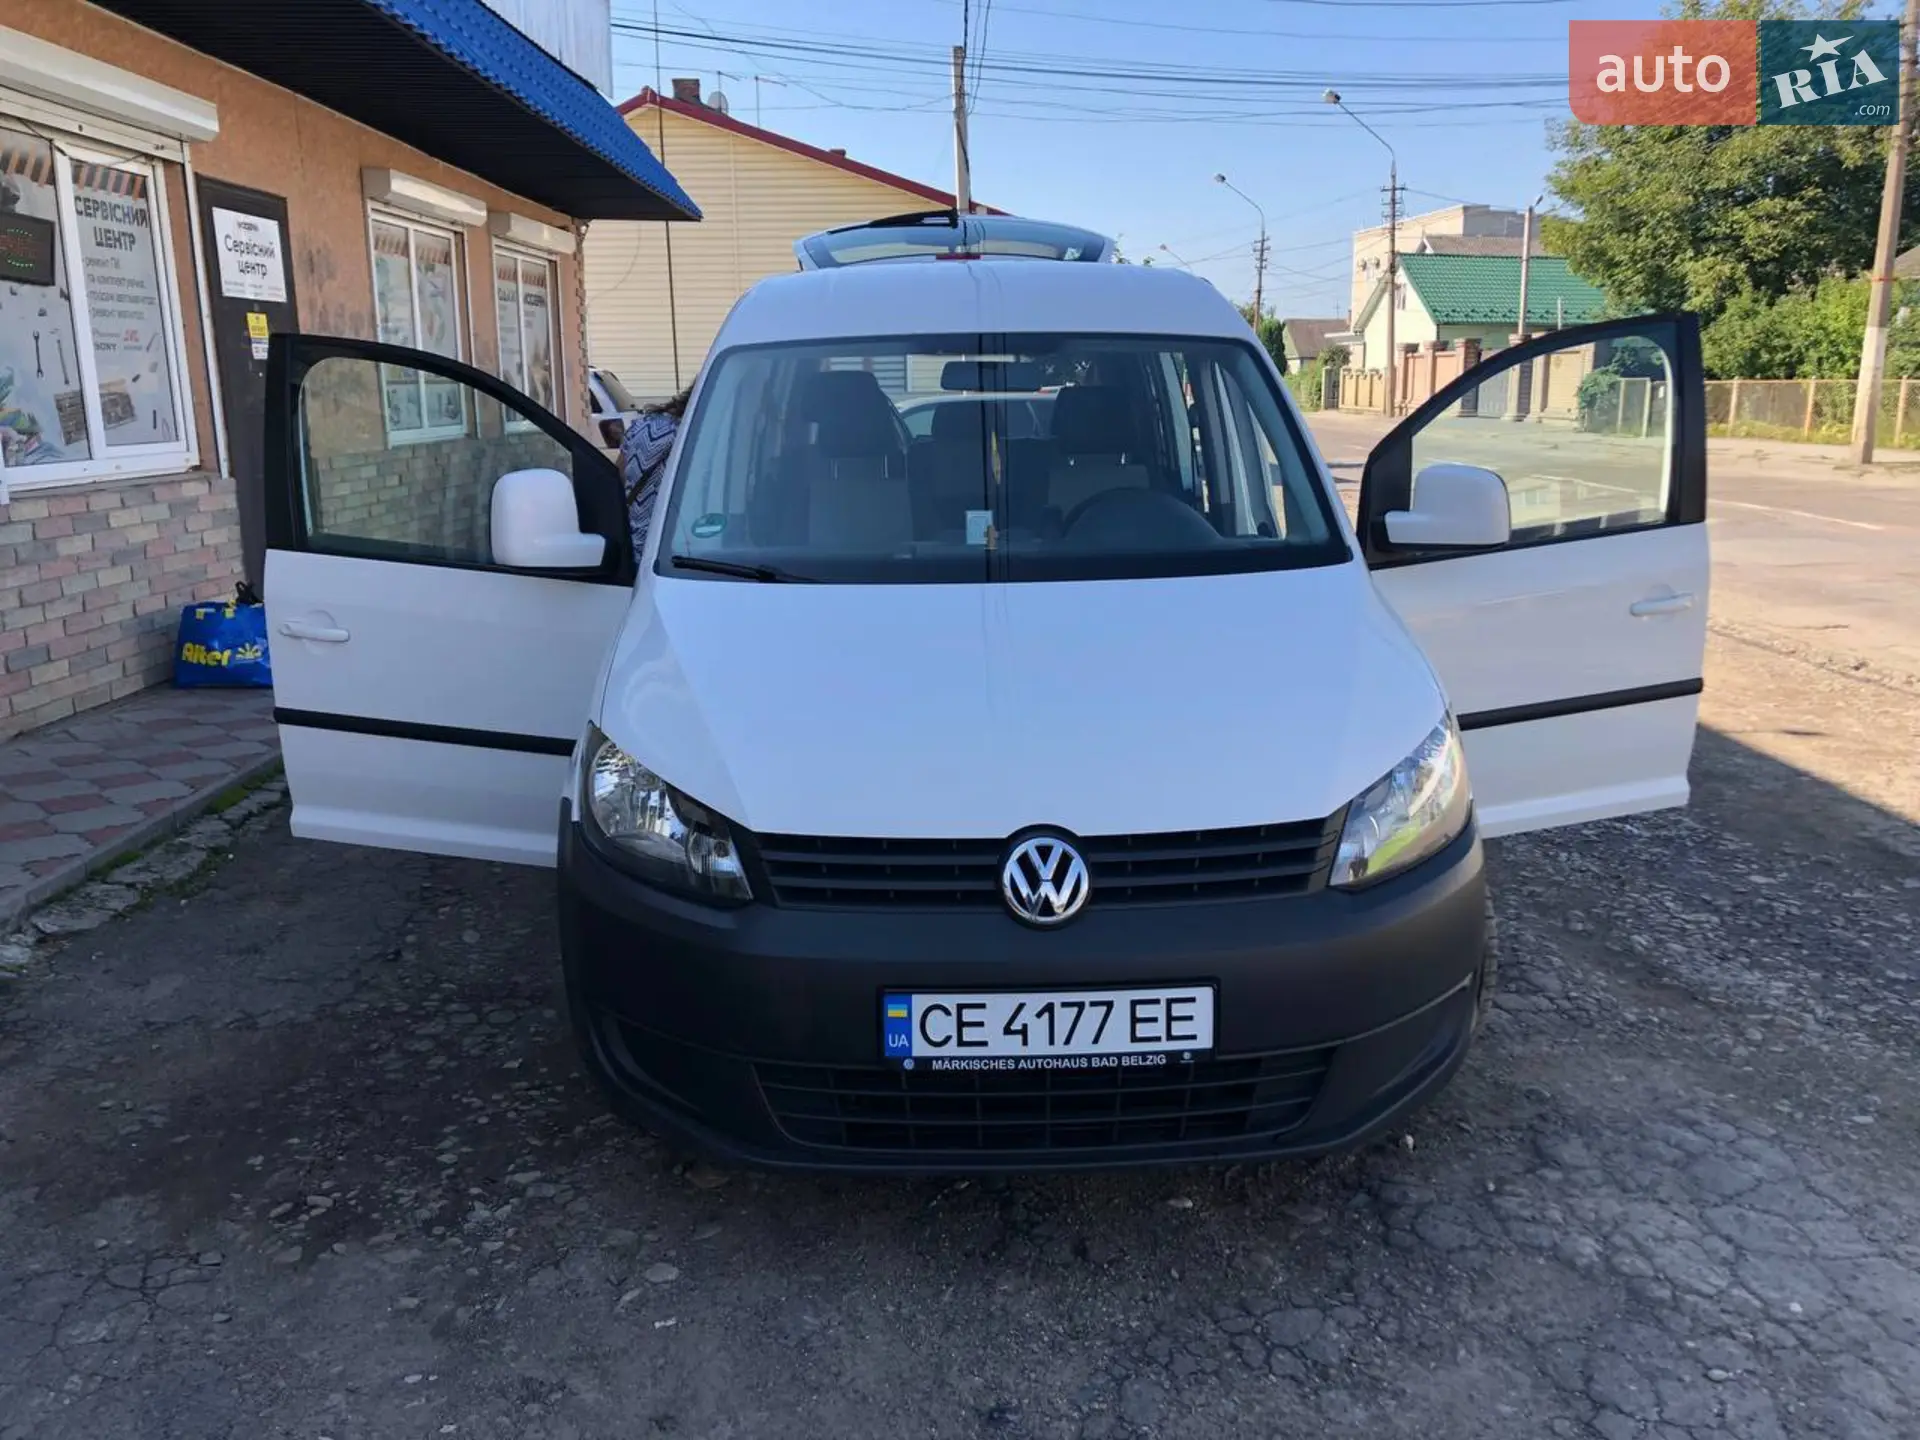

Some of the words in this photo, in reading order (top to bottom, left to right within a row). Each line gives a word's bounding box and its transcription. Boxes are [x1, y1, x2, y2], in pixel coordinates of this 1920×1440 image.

[93, 226, 136, 252] ЦЕНТР
[224, 234, 276, 259] Сервісний
[237, 260, 268, 280] центр
[919, 1002, 989, 1048] CE
[1002, 1000, 1114, 1047] 4177
[1129, 996, 1198, 1043] EE
[888, 1033, 910, 1048] UA
[931, 1058, 1016, 1070] MÄRKISCHES
[1018, 1056, 1089, 1069] AUTOHAUS
[1091, 1056, 1119, 1068] BAD
[1121, 1054, 1167, 1066] BELZIG
